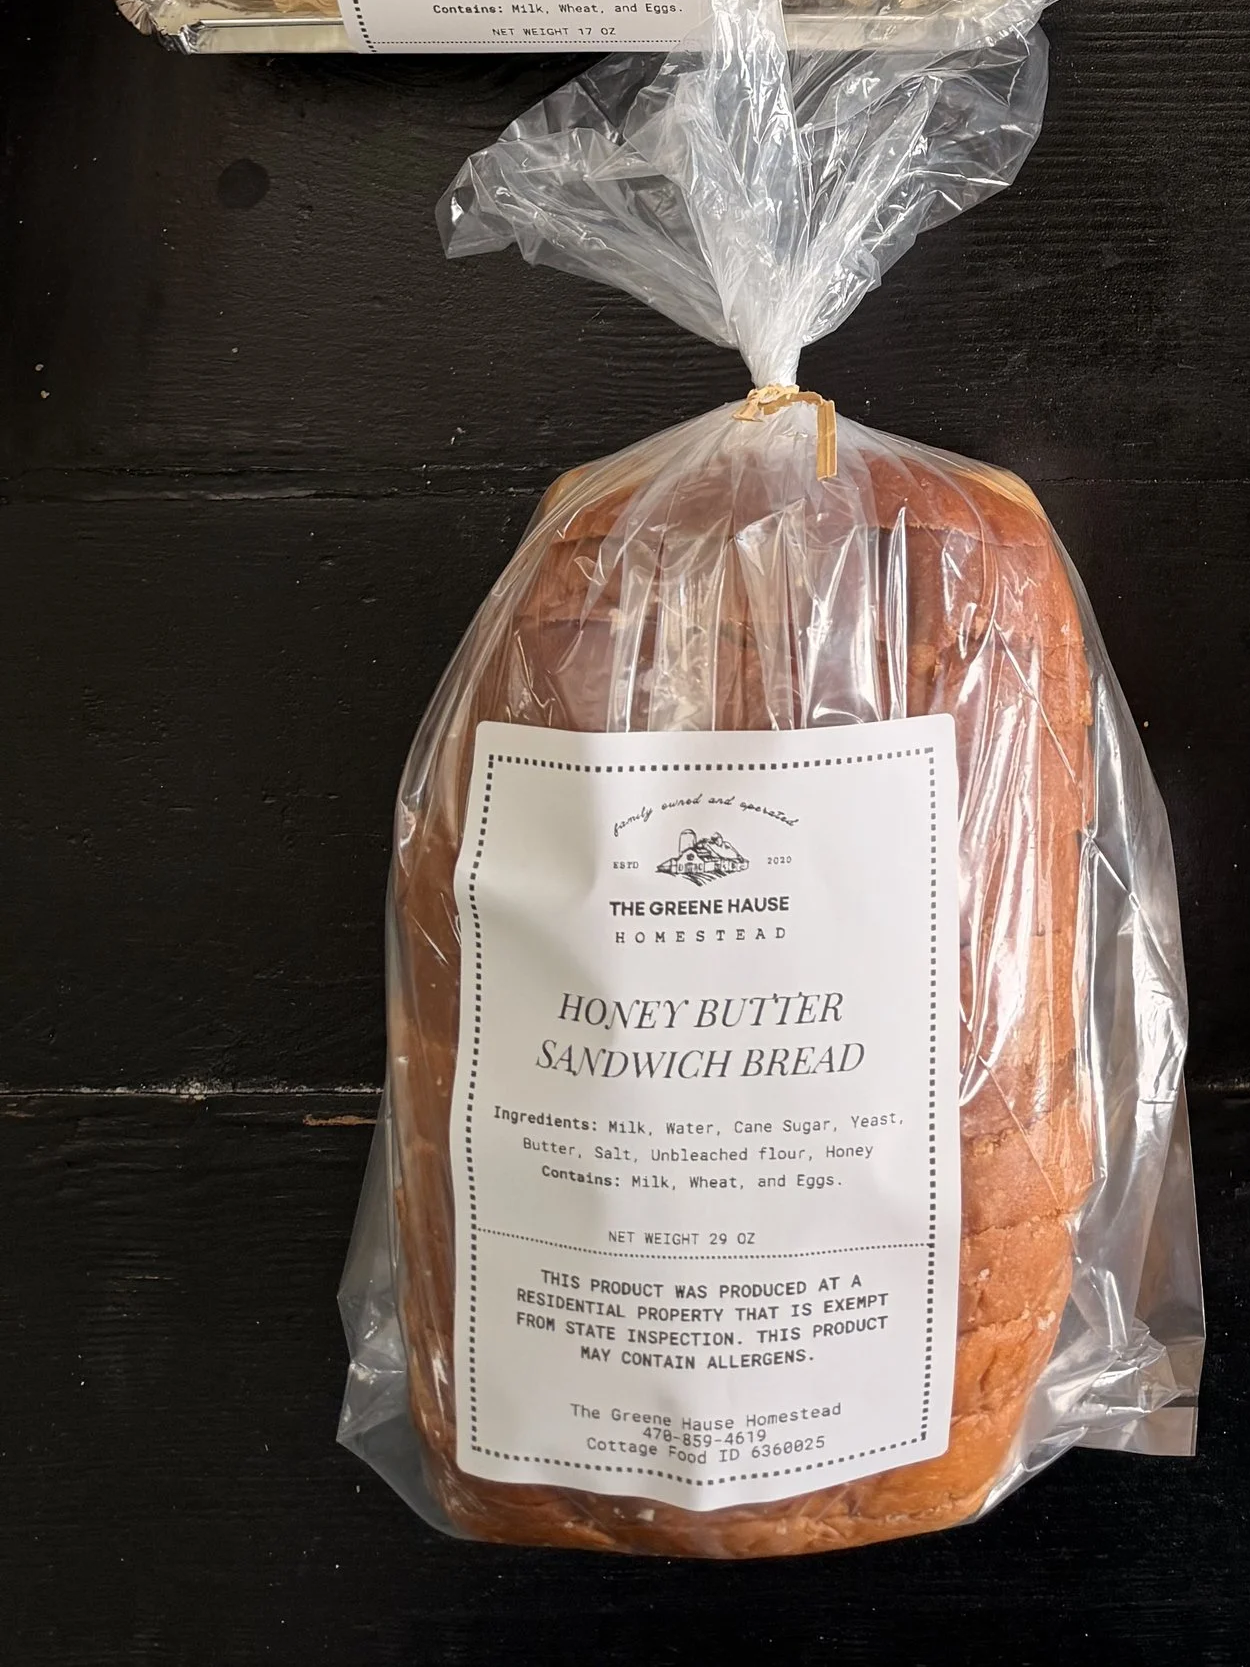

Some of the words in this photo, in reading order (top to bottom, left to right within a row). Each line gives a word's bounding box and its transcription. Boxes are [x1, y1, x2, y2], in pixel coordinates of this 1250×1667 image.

[609, 901, 645, 916] THE
[649, 899, 723, 916] GREENE
[728, 896, 789, 914] HAUSE
[558, 993, 689, 1030] HONEY
[693, 992, 843, 1028] BUTTER
[536, 1040, 732, 1079] SANDWICH
[740, 1043, 864, 1077] BREAD
[494, 1106, 596, 1131] Ingredients:
[609, 1121, 652, 1136] Milk,
[666, 1123, 720, 1136] Water,
[735, 1121, 772, 1133] Cane
[783, 1120, 836, 1135] Sugar,
[851, 1113, 902, 1128] Yeast,
[523, 1137, 581, 1158] Butter,
[595, 1146, 637, 1163] Salt,
[652, 1147, 747, 1161] Unbleached
[759, 1147, 812, 1161] flour,
[826, 1145, 873, 1159] Honey
[542, 1165, 619, 1187] Contains:
[632, 1175, 675, 1190] Milk,
[689, 1176, 743, 1189] Wheat,
[758, 1174, 785, 1187] and
[797, 1174, 841, 1189] Eggs.
[571, 1403, 600, 1419] The
[611, 1408, 672, 1427] Greene
[682, 1418, 734, 1431] Hause
[747, 1403, 840, 1427] Homestead
[587, 1437, 657, 1457] Cottage
[669, 1445, 706, 1464] Food
[719, 1448, 740, 1462] ID
[751, 1435, 825, 1460] 6360025
[643, 1427, 766, 1448] 470-859-4619
